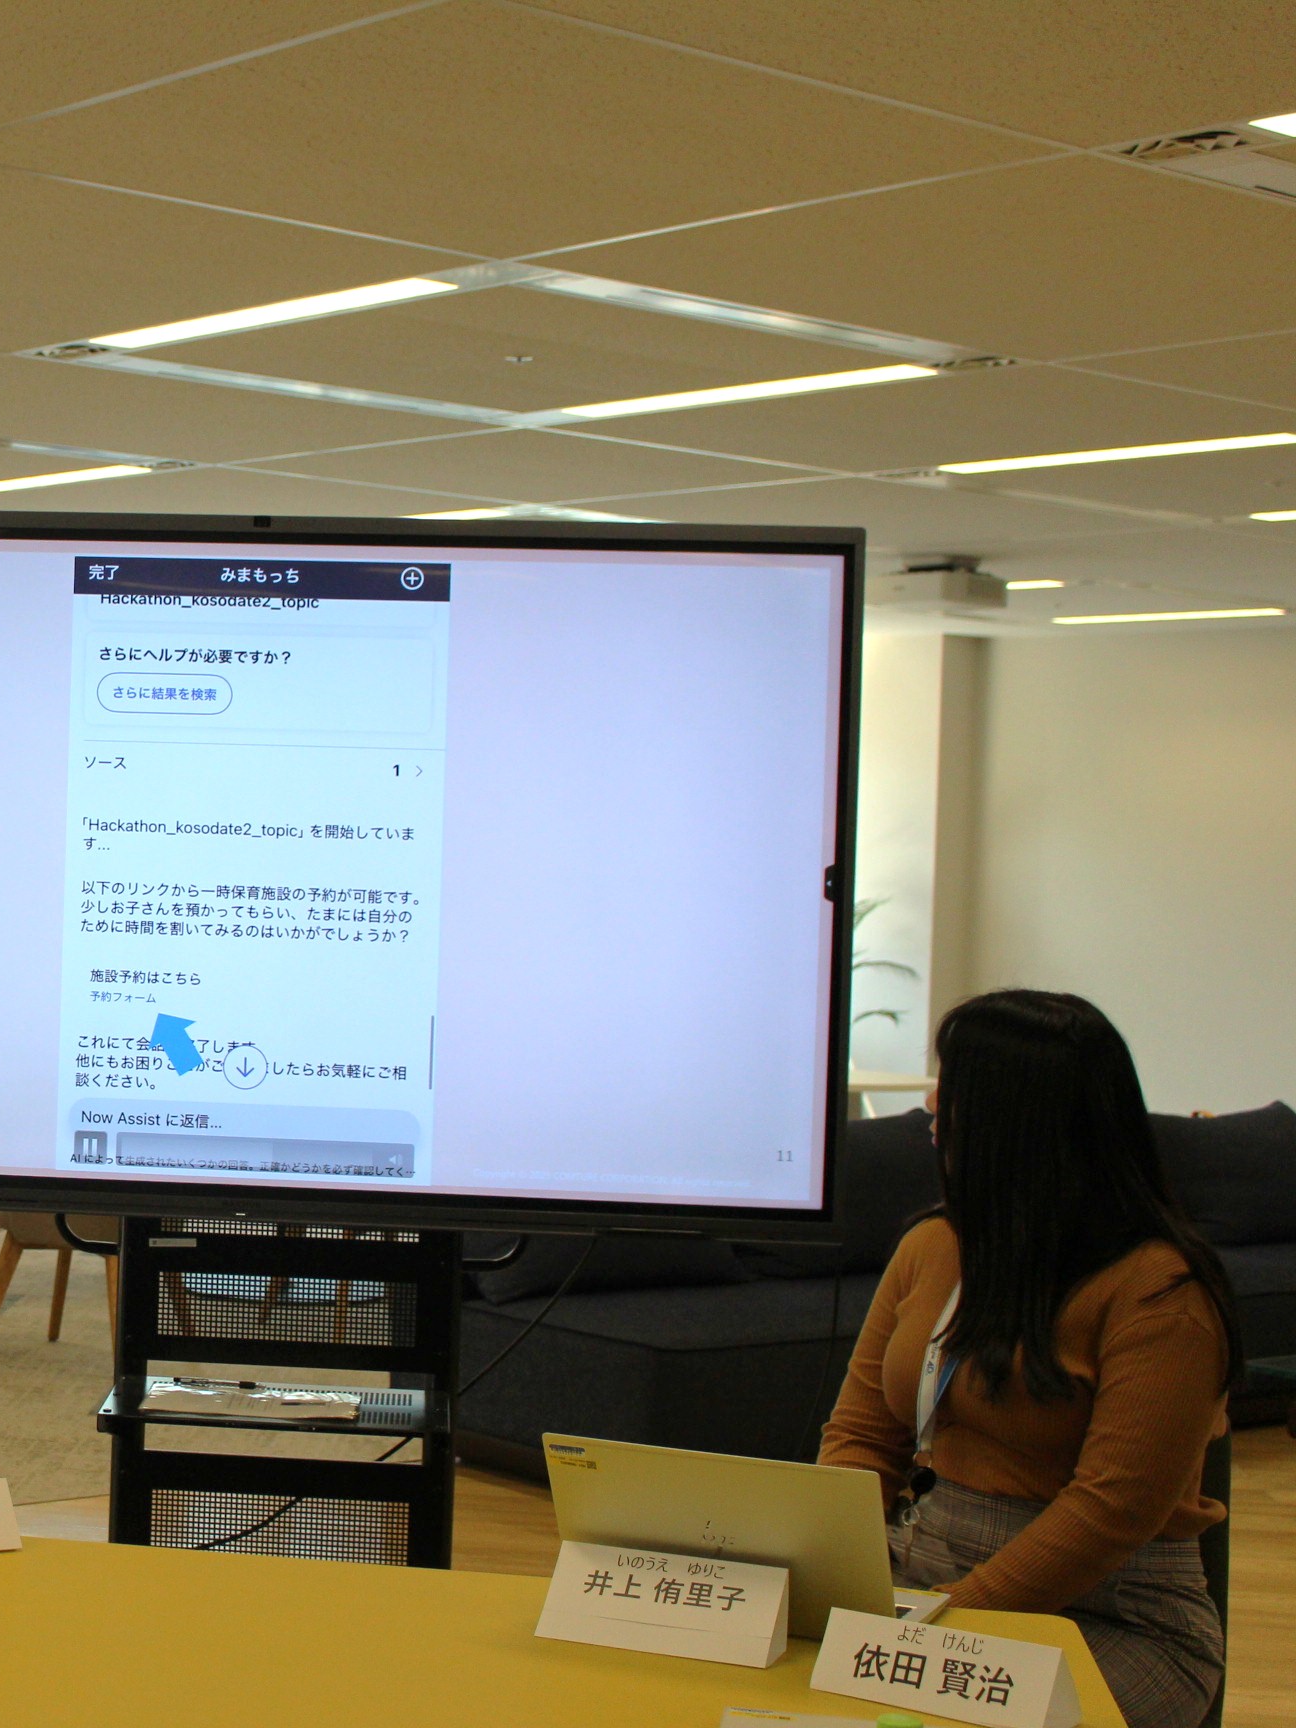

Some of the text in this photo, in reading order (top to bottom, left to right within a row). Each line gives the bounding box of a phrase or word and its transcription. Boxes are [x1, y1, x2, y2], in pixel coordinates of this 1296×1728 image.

[89, 564, 120, 581] 完了
[220, 567, 300, 584] みまもっち
[100, 594, 320, 610] Hackathon_kosodate2_topic
[98, 646, 292, 665] さらにヘルプが必要ですか？
[112, 685, 218, 702] さらに結果を検索
[84, 755, 128, 770] ソース
[392, 764, 401, 778] 1
[81, 879, 421, 906] 以下のリンクから一時保育施設の予約が可能です。
[80, 899, 413, 925] 少しお子さんを預かってもらい、たまには自分の
[80, 918, 409, 943] ために時間を割いてみるのはいかがでしょうか？
[89, 969, 202, 986] 施設予約はこちら
[89, 990, 157, 1004] 予約フォーム
[75, 1072, 157, 1091] 談ください。
[80, 1110, 114, 1126] Now
[117, 1111, 162, 1127] Assist
[776, 1149, 794, 1163] 11
[617, 1554, 726, 1581] いのうえ ゆりこ
[583, 1569, 747, 1612] 井上 侑里子
[896, 1626, 985, 1656] よだ けんじ
[853, 1641, 1015, 1707] 依田 賢治
